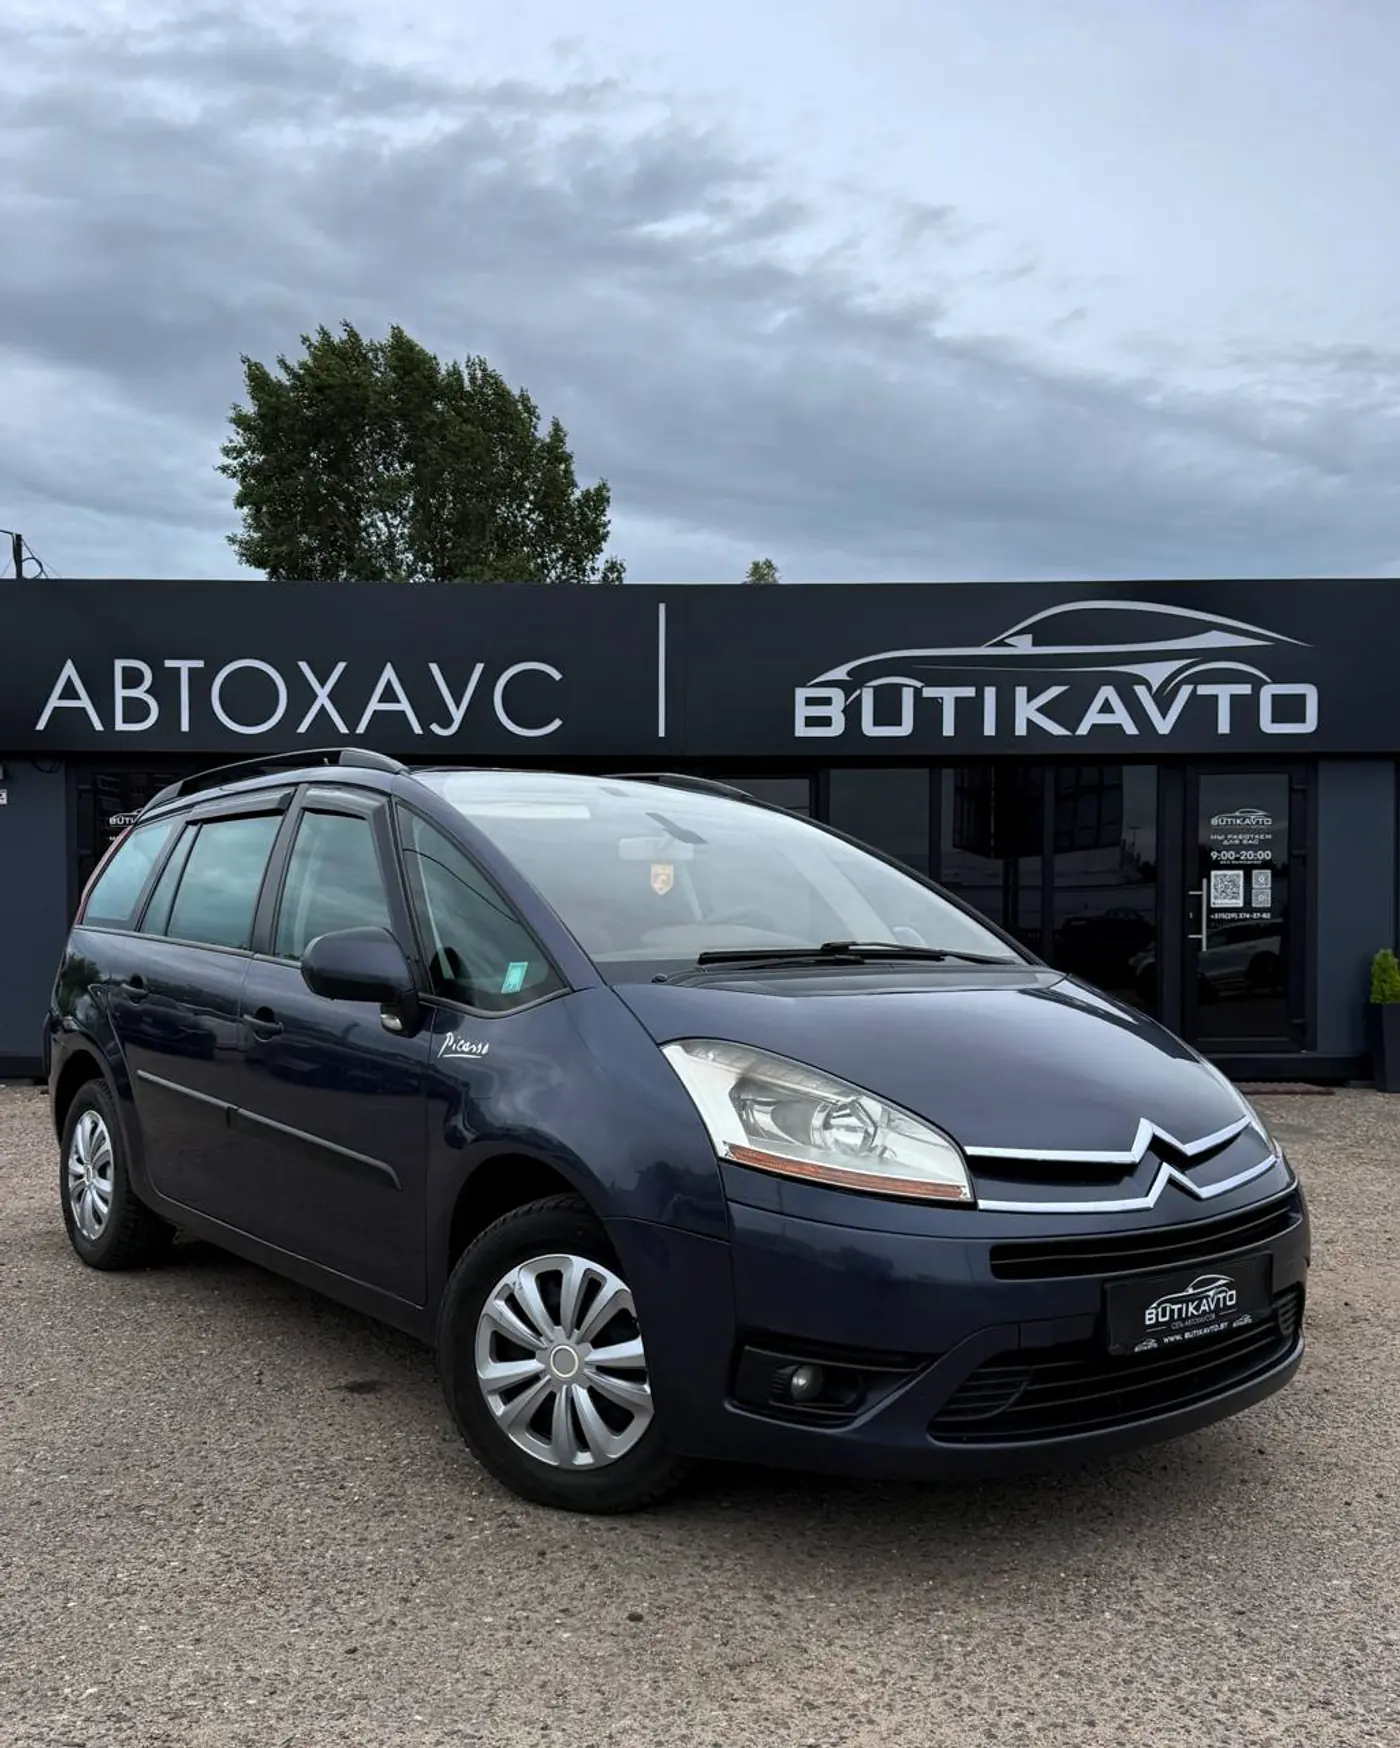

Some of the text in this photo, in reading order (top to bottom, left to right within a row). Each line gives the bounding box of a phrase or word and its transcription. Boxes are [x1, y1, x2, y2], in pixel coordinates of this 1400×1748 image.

[35, 658, 564, 738] АВТОХАУС
[794, 682, 1319, 738] BUTIKAVTO
[1211, 817, 1272, 825] BUTIKAVTO
[1210, 851, 1272, 860] 9:00-20:00
[1145, 1290, 1237, 1325] BUTIKAVTO
